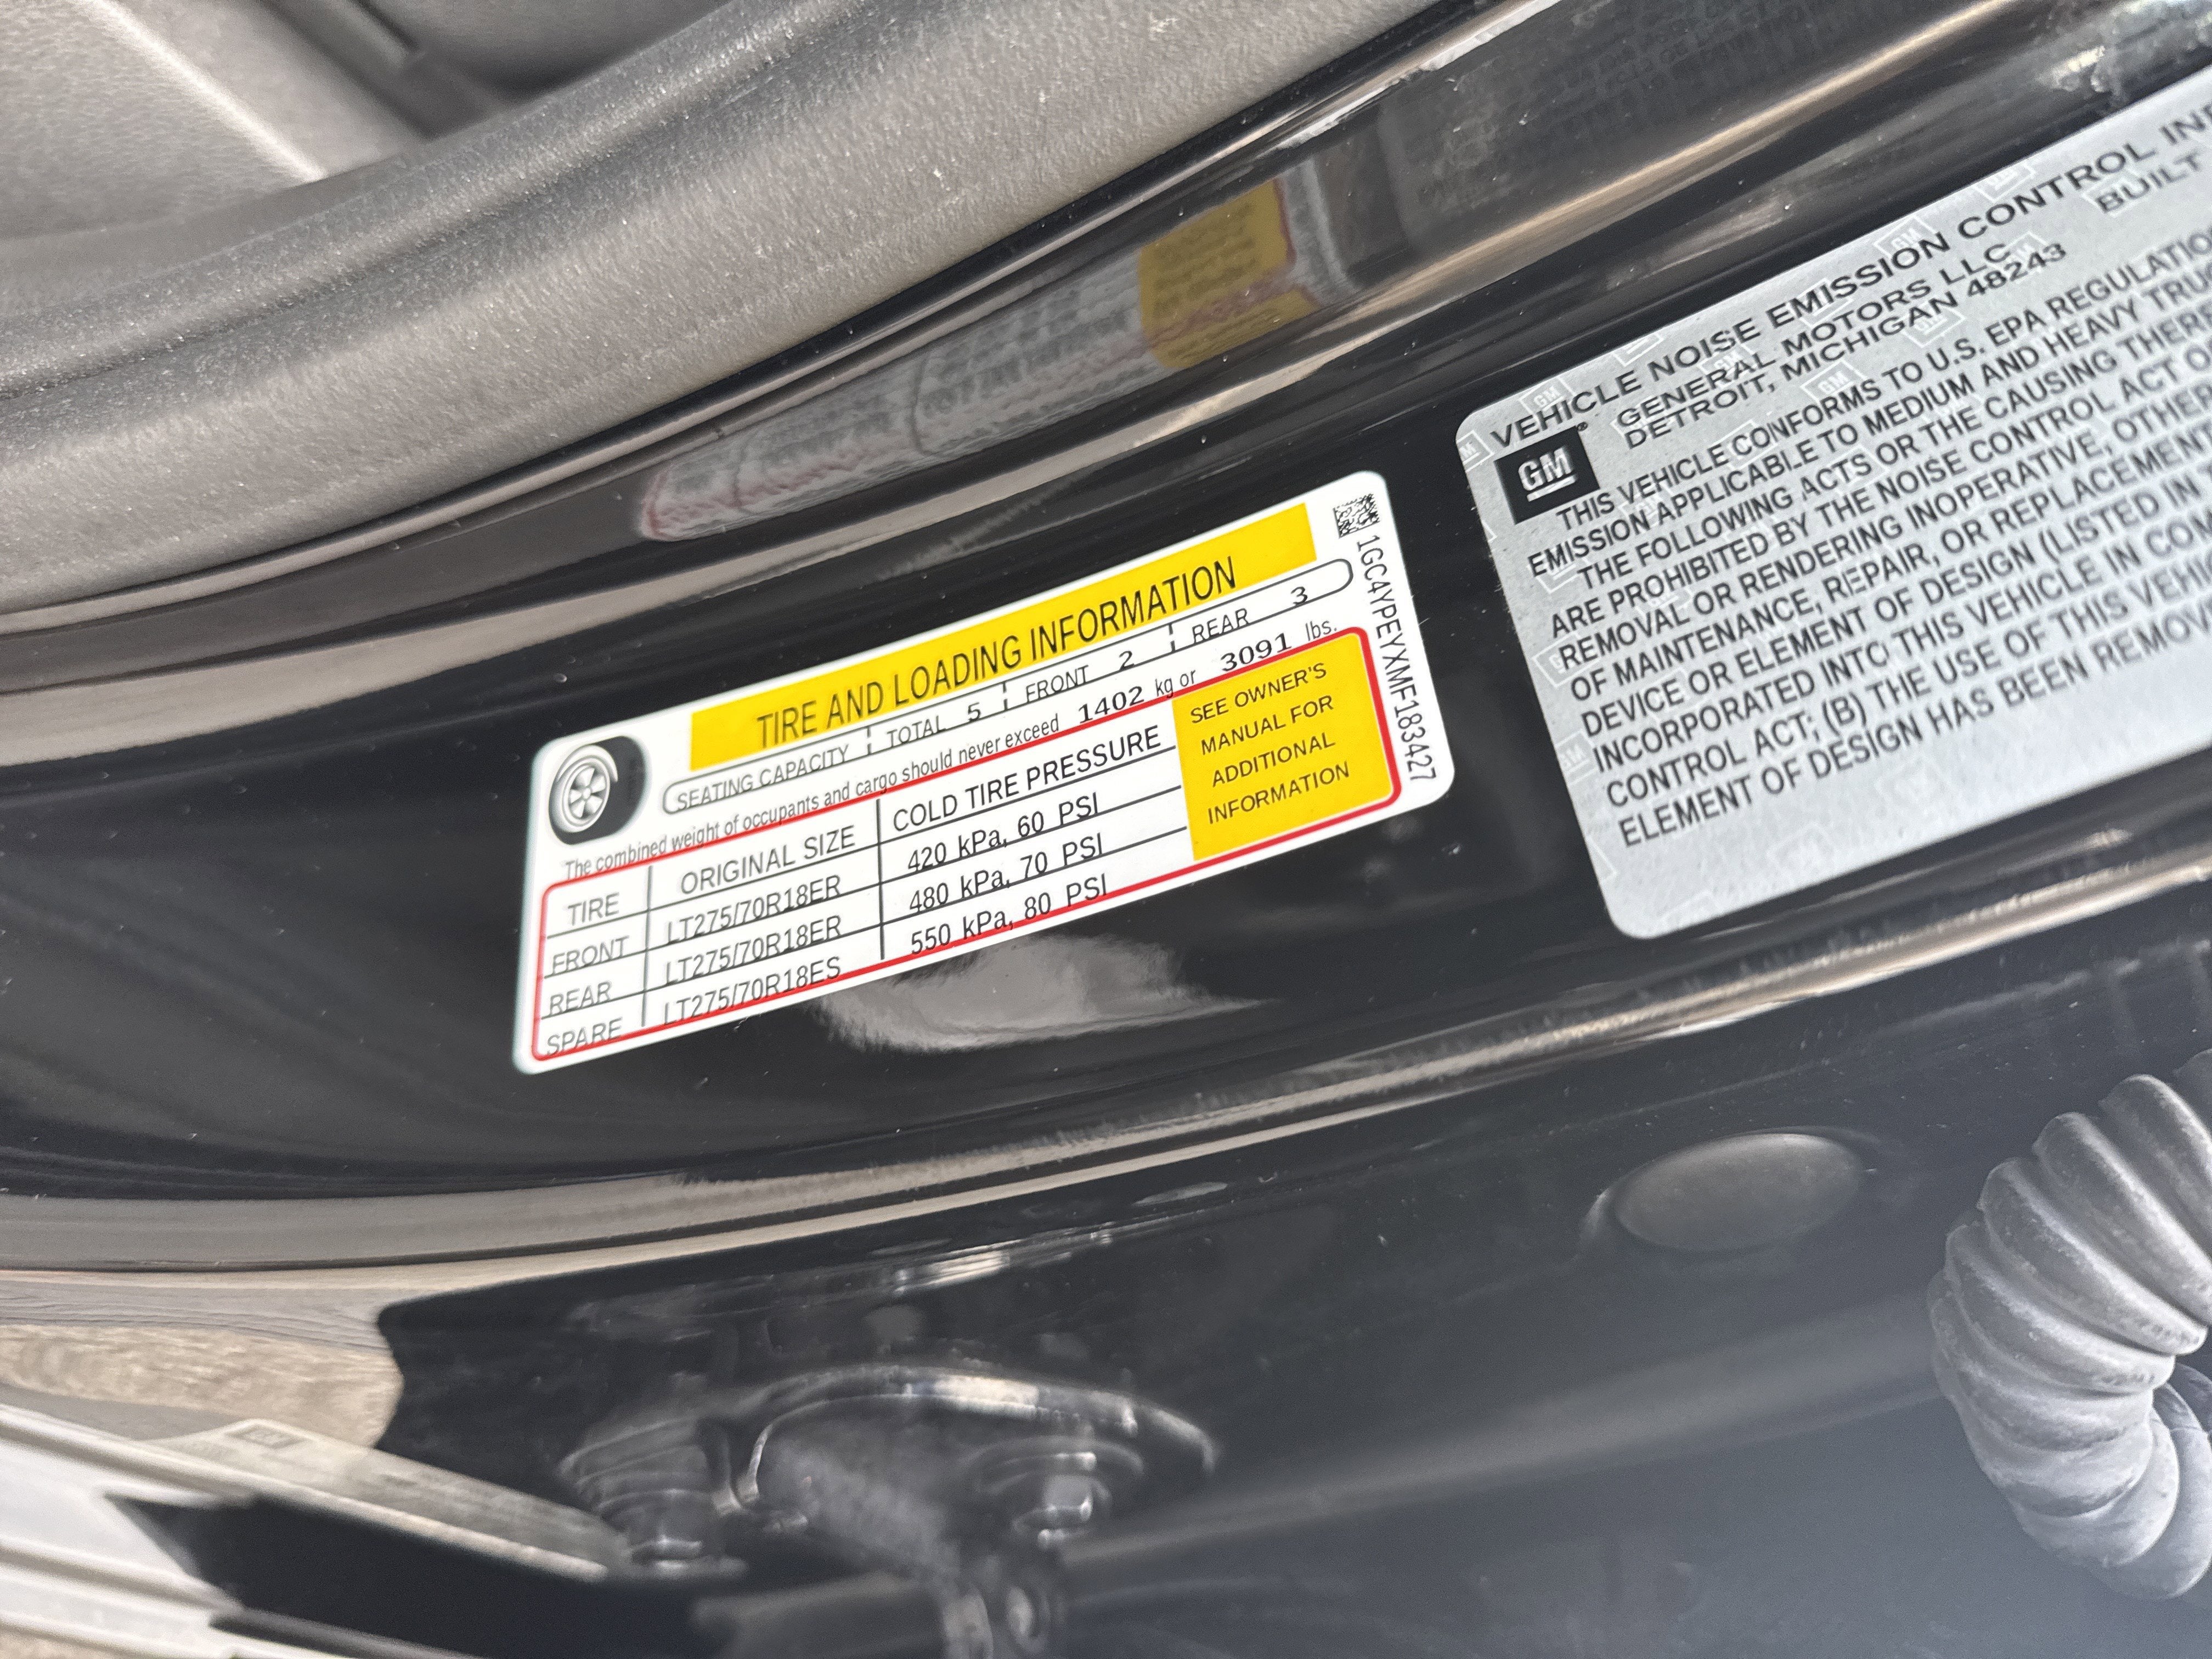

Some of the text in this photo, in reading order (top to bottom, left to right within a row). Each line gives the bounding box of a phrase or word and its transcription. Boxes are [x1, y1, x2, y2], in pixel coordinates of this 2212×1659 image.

[2095, 150, 2201, 213] BUILT
[1490, 370, 1643, 448] VEHICLE
[1646, 318, 1761, 382] NOISE
[1765, 232, 1950, 328] EMISSION
[1957, 143, 2157, 240] CONTROL
[1616, 242, 2012, 427] GENERAL MOTORS LLC
[1556, 493, 1615, 530] THIS
[1616, 443, 1730, 505] VEHICLE
[1731, 378, 1882, 458] CONFORMS
[1881, 360, 1923, 391] TO
[1925, 336, 1985, 373] U.S.
[1983, 308, 2047, 348] EPA
[2045, 225, 2212, 319] REGULATIO
[1624, 242, 2067, 450] DETROIT, MICHIGAN 48243
[1528, 261, 2212, 577] EMISSION APPLICABLE TO MEDIUM AND HEAVY TRU
[1518, 446, 1575, 490] GM
[1551, 597, 1605, 639] ARE
[1607, 531, 1770, 615] PROHIBITED
[1771, 512, 1810, 548] BY
[1816, 487, 1876, 529] THE
[1874, 449, 1968, 504] NOISE
[1967, 390, 2118, 464] CONTROL
[2118, 356, 2179, 403] ACT
[1577, 551, 1633, 589] THE
[1637, 487, 1795, 568] FOLLOWING
[1801, 452, 1873, 501] ACTS
[1874, 433, 1922, 466] OR
[1918, 405, 1983, 448] THE
[1983, 347, 2119, 420] CAUSING
[1559, 602, 1691, 670] REMOVAL
[1692, 582, 1736, 616] OR
[1739, 514, 1904, 600] RENDERING
[1906, 430, 2113, 531] INOPERATIVE,
[1191, 586, 1309, 645] REAR 3
[1570, 667, 1609, 702] OF
[1613, 587, 1824, 687] MAINTENANCE,
[1822, 542, 1941, 603] REPAIR,
[1940, 518, 1991, 555] OR
[1581, 474, 2202, 737] DEVICE OR ELEMENT OF DESIGN (LISTED IN
[757, 555, 1237, 749] TIRE AND LOADING INFORMATION
[1024, 651, 1136, 704] FRONT 2
[1356, 535, 1437, 781] 1GC4YPEYXMF183427
[1592, 669, 1816, 772] INCORPORATED
[1819, 640, 1889, 687] INTO
[1891, 611, 1964, 657] THIS
[1966, 556, 2103, 627] VEHICLE
[2102, 538, 2141, 576] IN
[887, 702, 982, 749] TOTAL 5
[1190, 662, 1328, 724] SEE OWNER'S
[1200, 695, 1335, 756] MANUAL FOR
[1607, 740, 1747, 807] CONTROL
[1753, 712, 1820, 757] ACT;
[1821, 691, 1867, 736] (B)
[1865, 667, 1932, 710] THE
[1932, 638, 2002, 686] USE
[2003, 620, 2046, 658] OF
[2048, 590, 2129, 639] THIS
[1618, 595, 2212, 848] ELEMENT OF DESIGN HAS BEEN REMOV
[566, 618, 1339, 881] The combined weight of occupants and cargo should never exceed 1402 kg or 3091 lbs.
[676, 744, 850, 811] SEATING CAPACITY
[893, 725, 1162, 831] COLD TIRE PRESSURE
[1212, 731, 1336, 788] ADDITIONAL
[907, 792, 1099, 873] 420 kPa, 60 PSI
[1207, 760, 1351, 825] INFORMATION
[680, 825, 856, 895] ORIGINAL SIZE
[909, 832, 1103, 914] 480 kPa, 70 PSI
[568, 892, 620, 927] TIRE
[665, 915, 842, 985] LT275/70R18ER
[667, 874, 842, 945] LT275/70R18ER
[911, 873, 1108, 955] 550 kPa, 80 PSI
[552, 935, 629, 976] FRONT
[664, 956, 842, 1025] LT275/70R18ES
[546, 1017, 623, 1057] SPARE
[549, 980, 613, 1015] REAR
